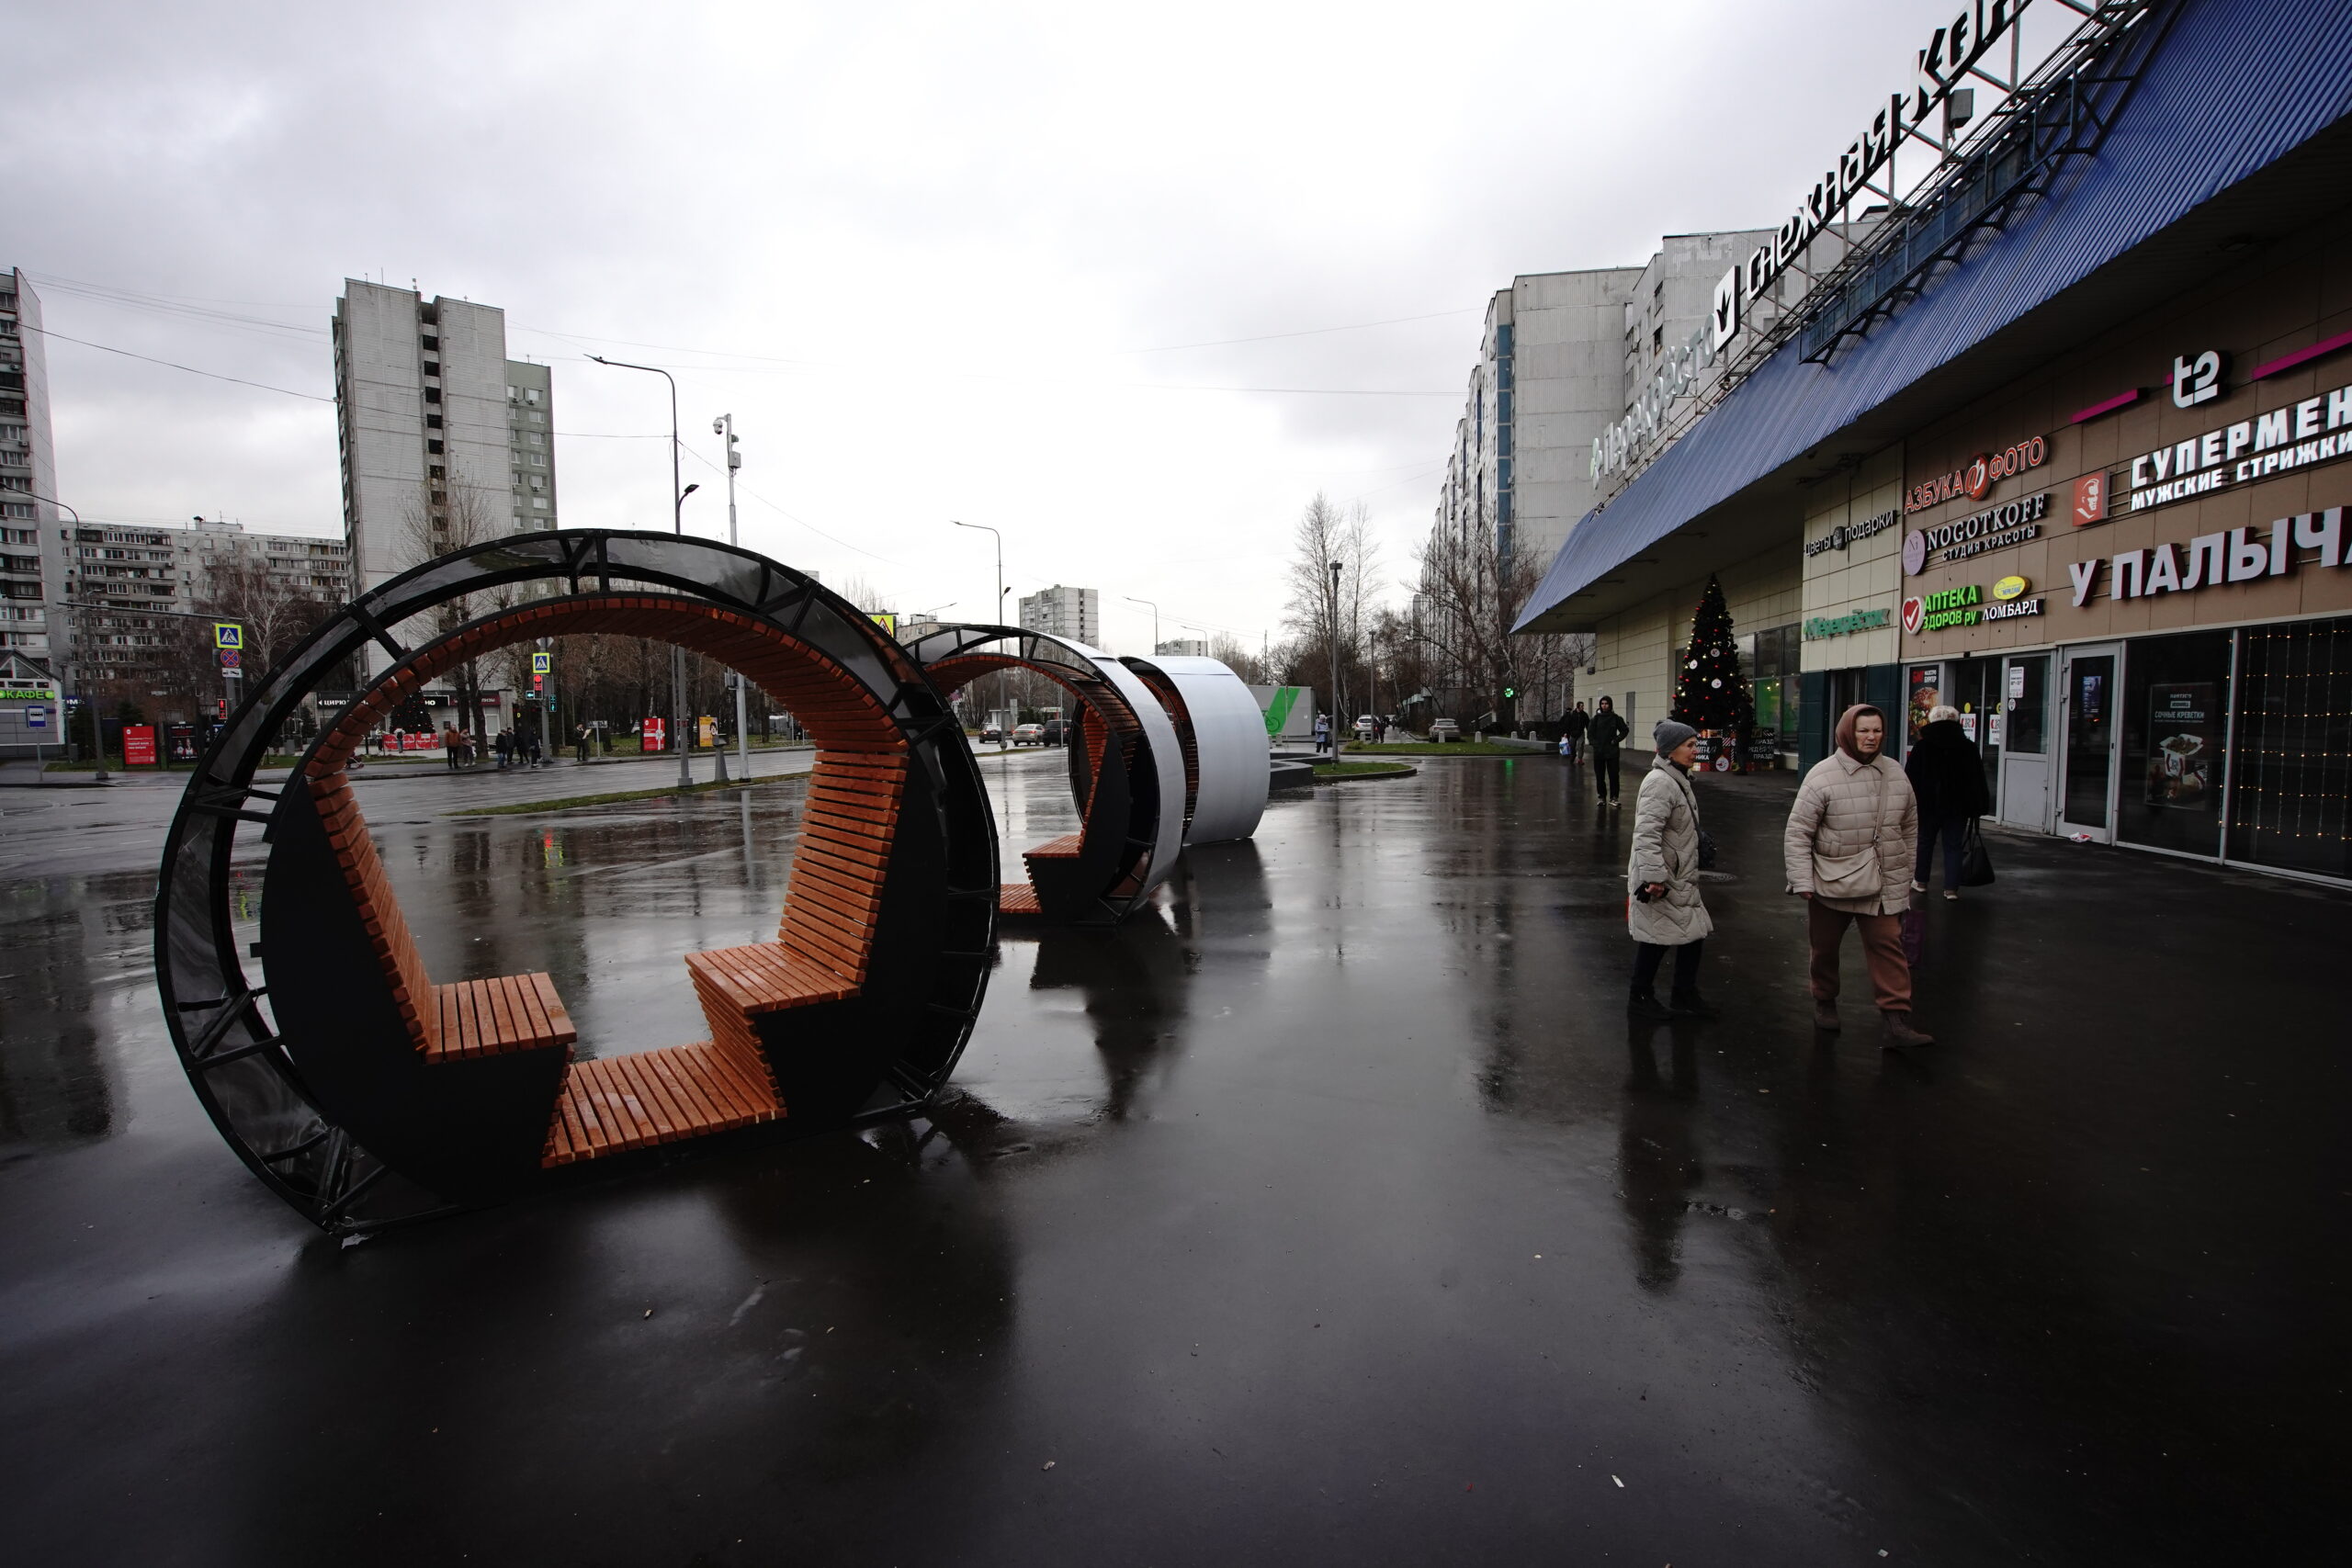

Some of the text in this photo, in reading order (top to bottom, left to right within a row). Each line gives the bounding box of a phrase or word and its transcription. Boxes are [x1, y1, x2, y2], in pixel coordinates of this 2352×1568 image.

[1604, 313, 1716, 476] Перекрёсто
[2173, 350, 2221, 409] t2
[1904, 435, 2043, 514] АЗБУКА ФОТО
[2131, 468, 2223, 511] МУЖСКИЕ
[1805, 510, 1894, 557] цветы подарки
[1926, 492, 2044, 551] NOGOTKOFF
[1941, 539, 1980, 560] СТУДИЯ
[1983, 525, 2036, 550] КРАСОТЫ
[2069, 505, 2352, 607] У ПАЛЫЧ
[1922, 609, 1962, 630] ЗДОРОВ
[1924, 584, 1977, 613] АПТЕКА
[1982, 599, 2038, 621] ЛОМБАРД
[6, 690, 45, 699] КАФЕ
